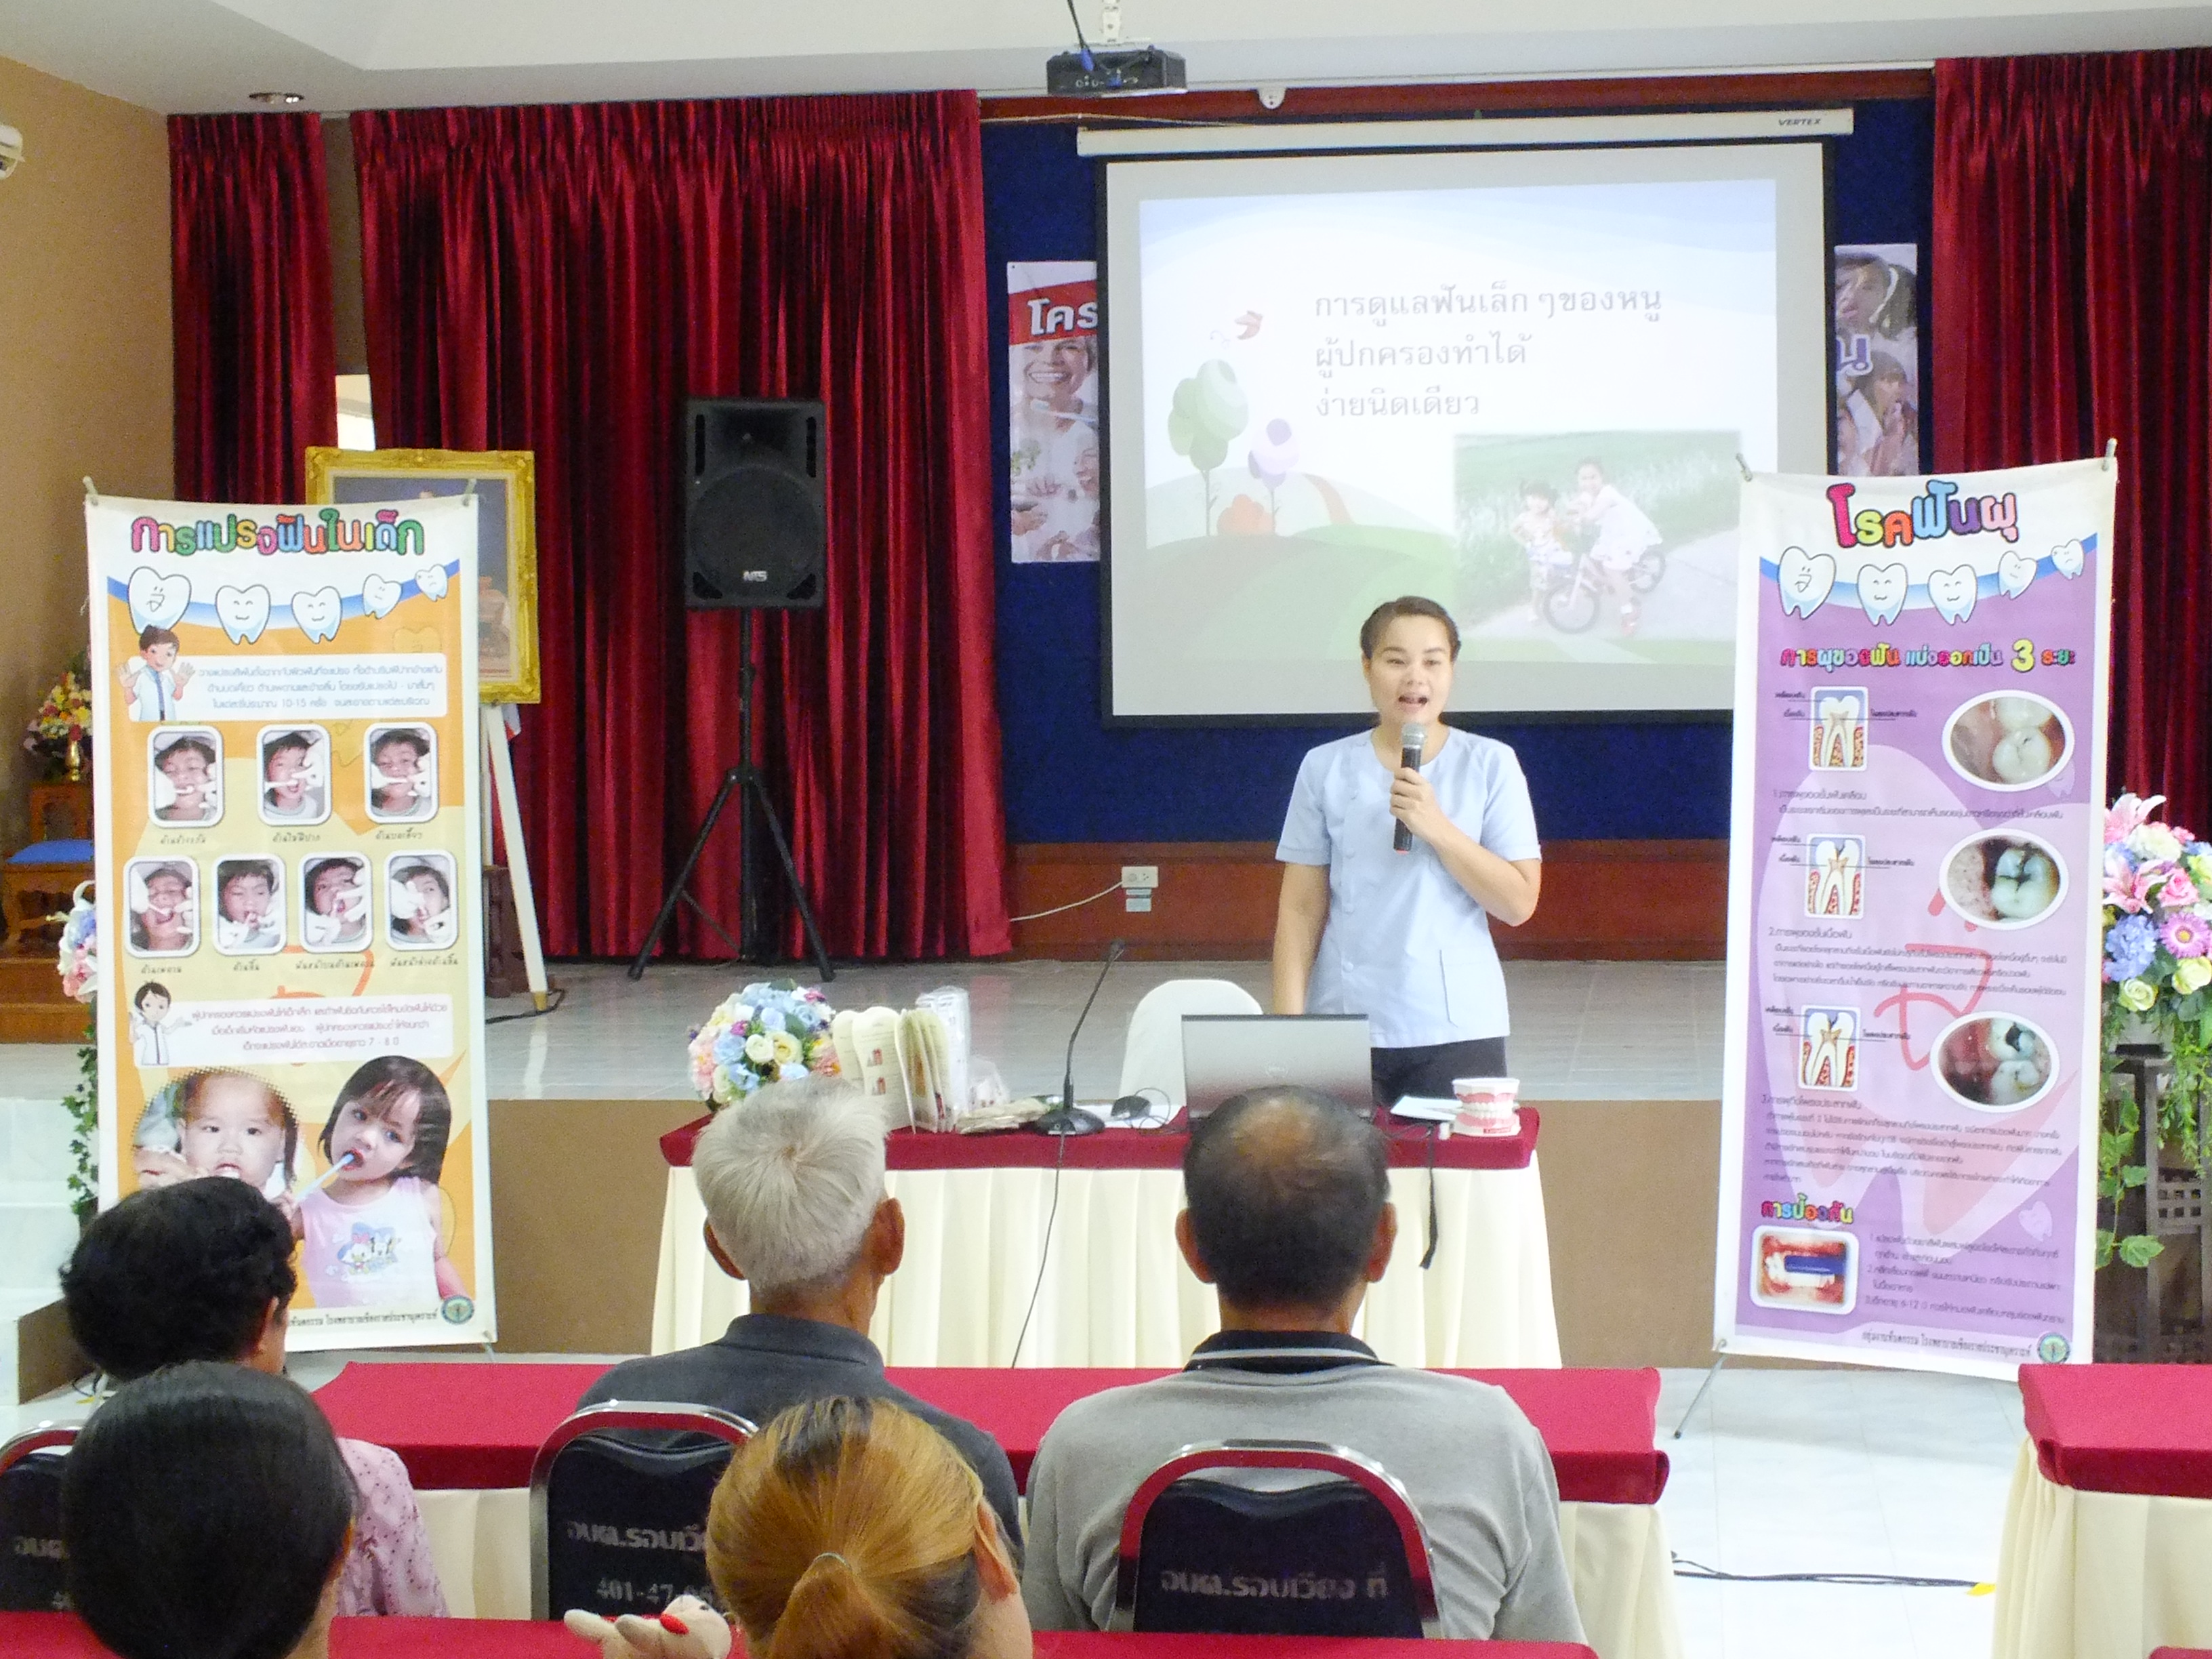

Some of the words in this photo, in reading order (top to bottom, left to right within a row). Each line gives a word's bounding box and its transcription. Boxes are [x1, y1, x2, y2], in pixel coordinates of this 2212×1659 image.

[1316, 331, 1532, 378] ผู้ปกครองทำได้
[1316, 385, 1480, 417] ง่ายนิดเดียว
[131, 508, 425, 556] การแปรงฟันในเด็ก
[1826, 478, 2019, 548] โรคฟันผุ
[1780, 642, 1902, 674] การผุของฟัน
[1905, 642, 2004, 668] แบ่งออกเป็น
[2011, 637, 2036, 674] 3
[2041, 648, 2076, 667] ระยะ
[1761, 1191, 1854, 1225] การป้องกัน
